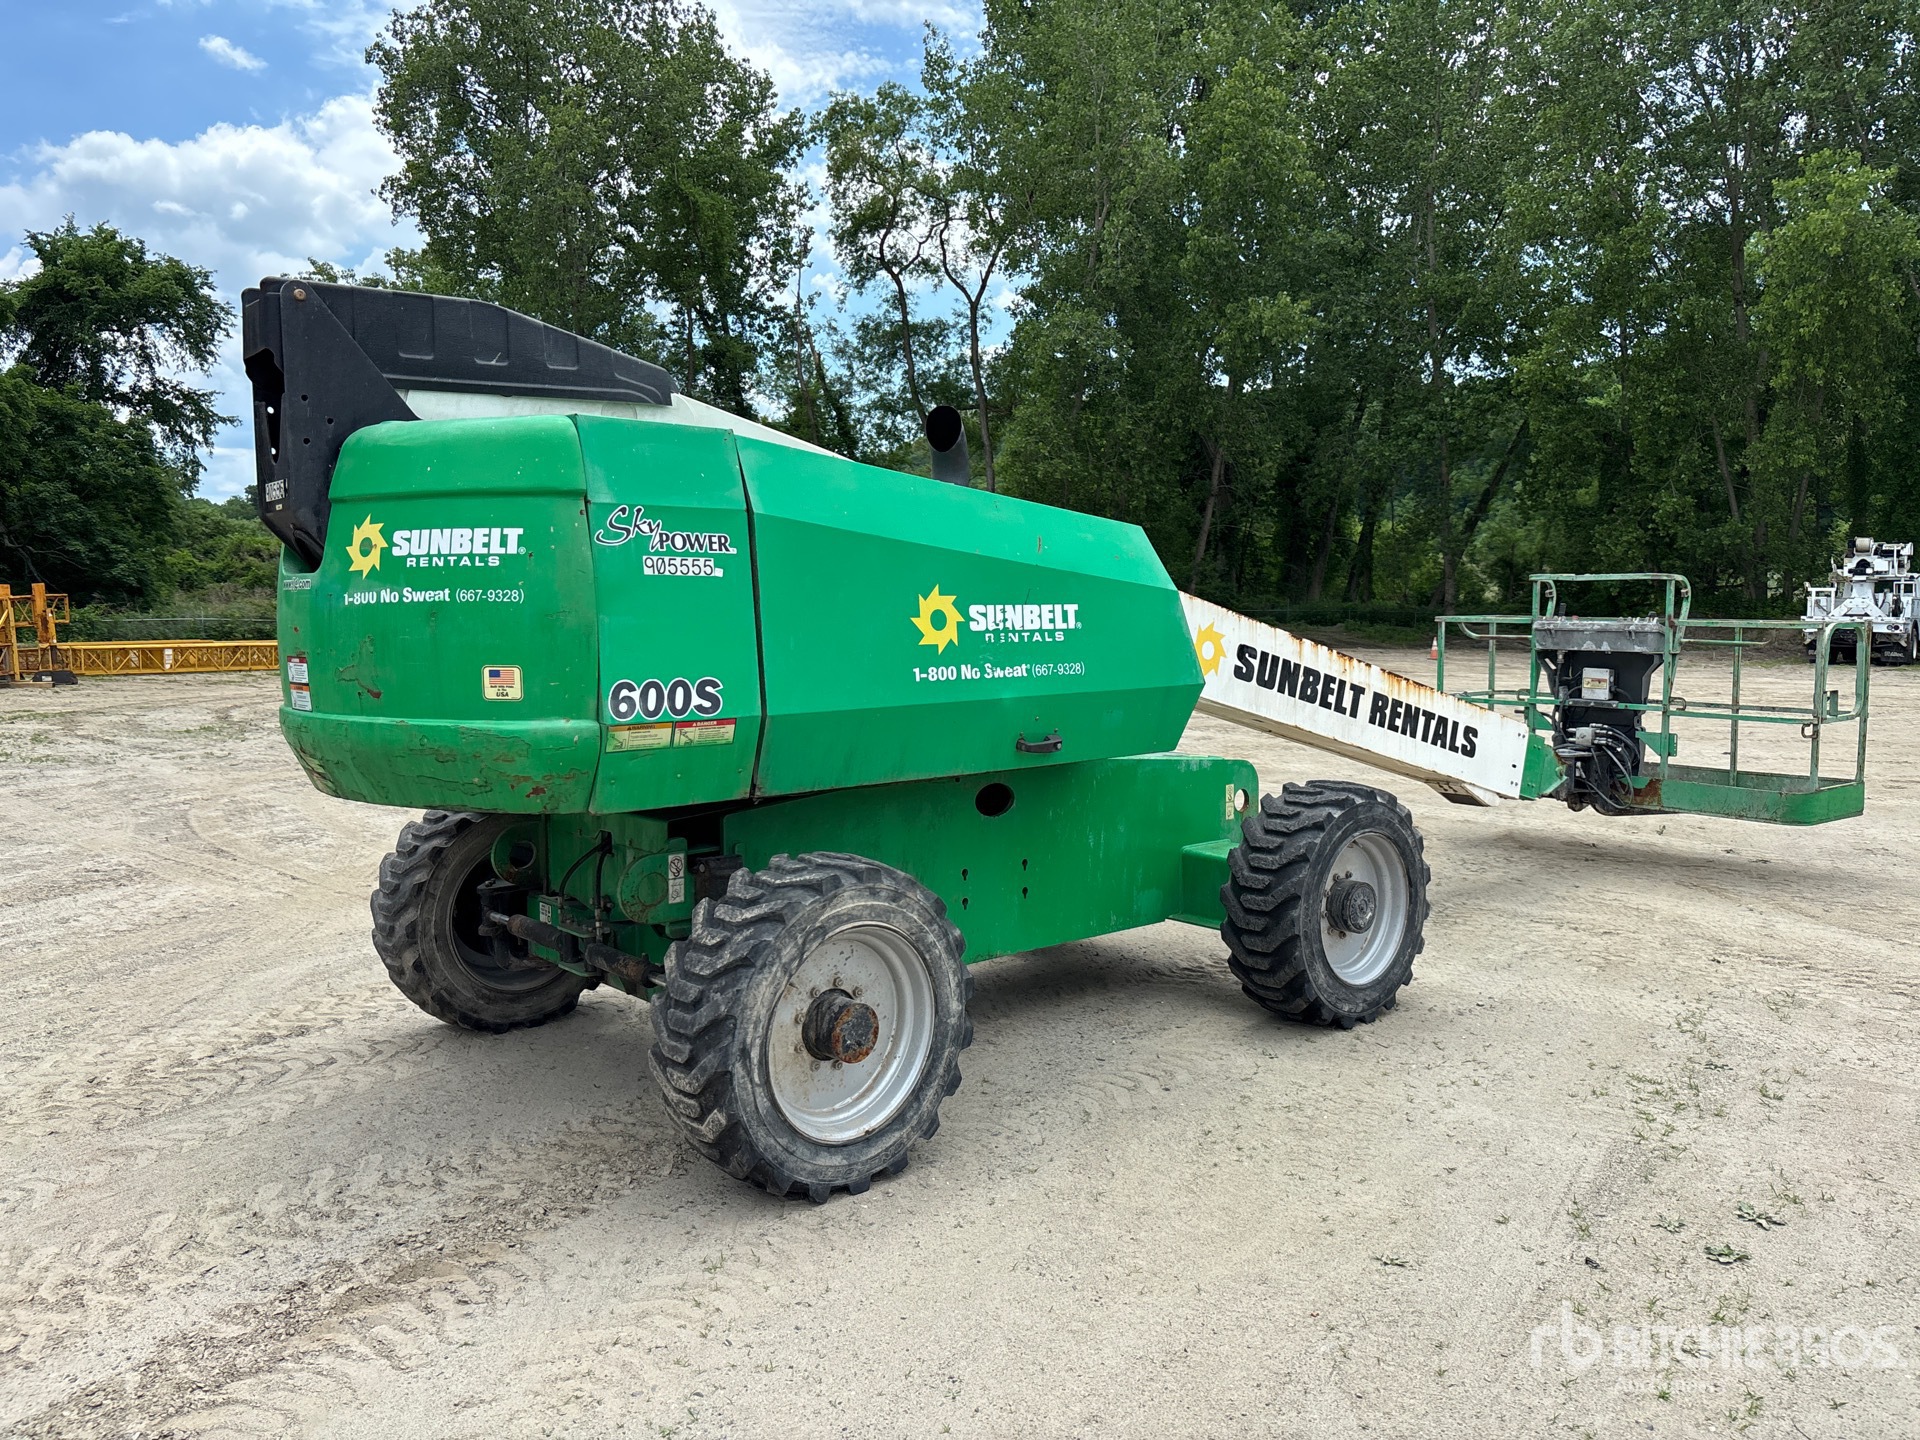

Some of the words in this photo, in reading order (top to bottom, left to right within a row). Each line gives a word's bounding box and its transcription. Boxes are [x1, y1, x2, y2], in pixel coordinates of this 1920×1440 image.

[392, 528, 524, 556] SUNBELT
[595, 505, 662, 552] Sky
[658, 531, 732, 554] POWER
[406, 556, 500, 568] RENTALS
[344, 591, 377, 605] 1-800
[380, 588, 399, 603] No
[402, 587, 451, 602] Sweat
[455, 588, 525, 604] (667-9328)
[968, 604, 1079, 631] SUNBELT
[985, 631, 1065, 643] RENTALS
[913, 666, 957, 682] 1-800
[960, 664, 981, 680] No
[984, 663, 1028, 679] Sweat
[1031, 661, 1085, 678] (667-9328)
[608, 676, 724, 721] 600S
[1233, 643, 1366, 720] SUNBELT
[1368, 691, 1479, 759] RENTALS
